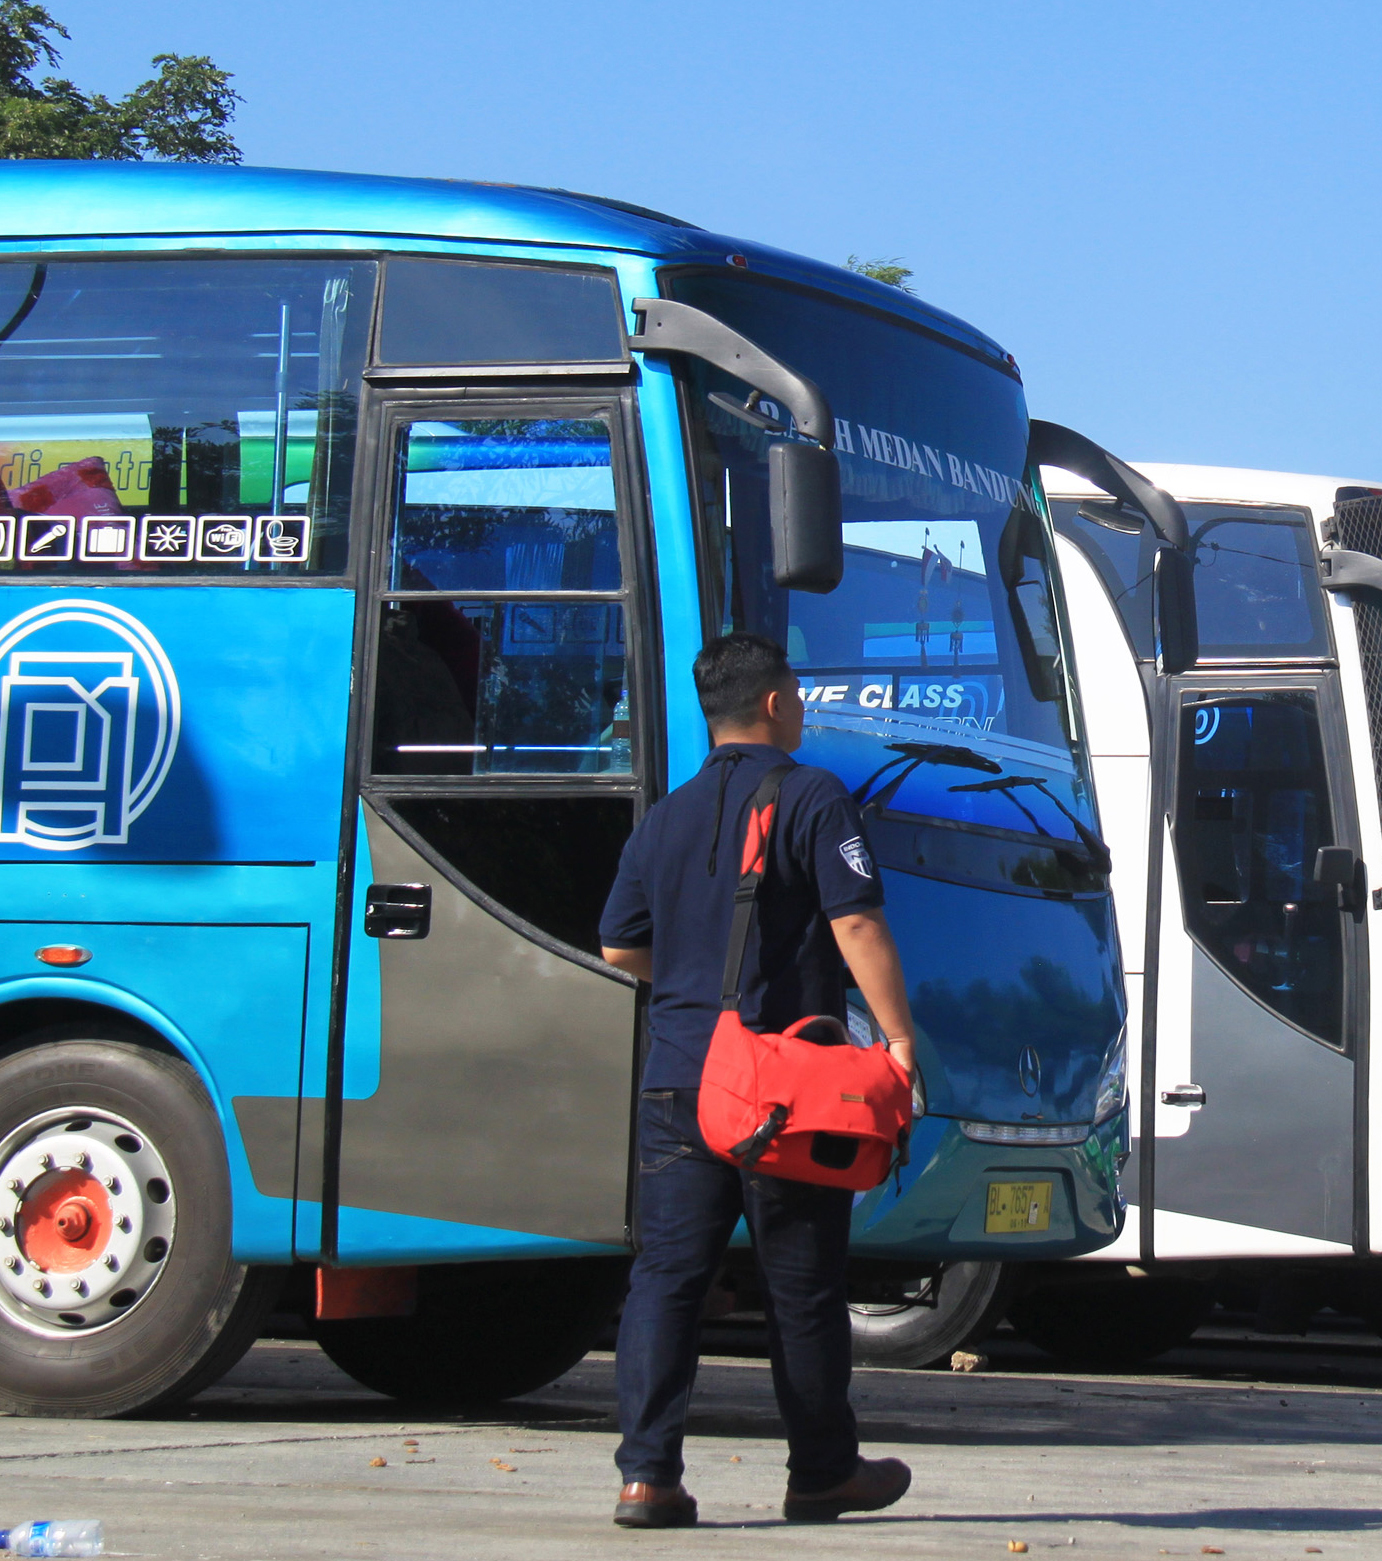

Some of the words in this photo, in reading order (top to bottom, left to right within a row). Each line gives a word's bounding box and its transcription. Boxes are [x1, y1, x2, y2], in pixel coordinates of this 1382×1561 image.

[857, 424, 944, 481] MEDAN
[946, 452, 1044, 518] BANDUNG
[859, 684, 965, 709] CLASS
